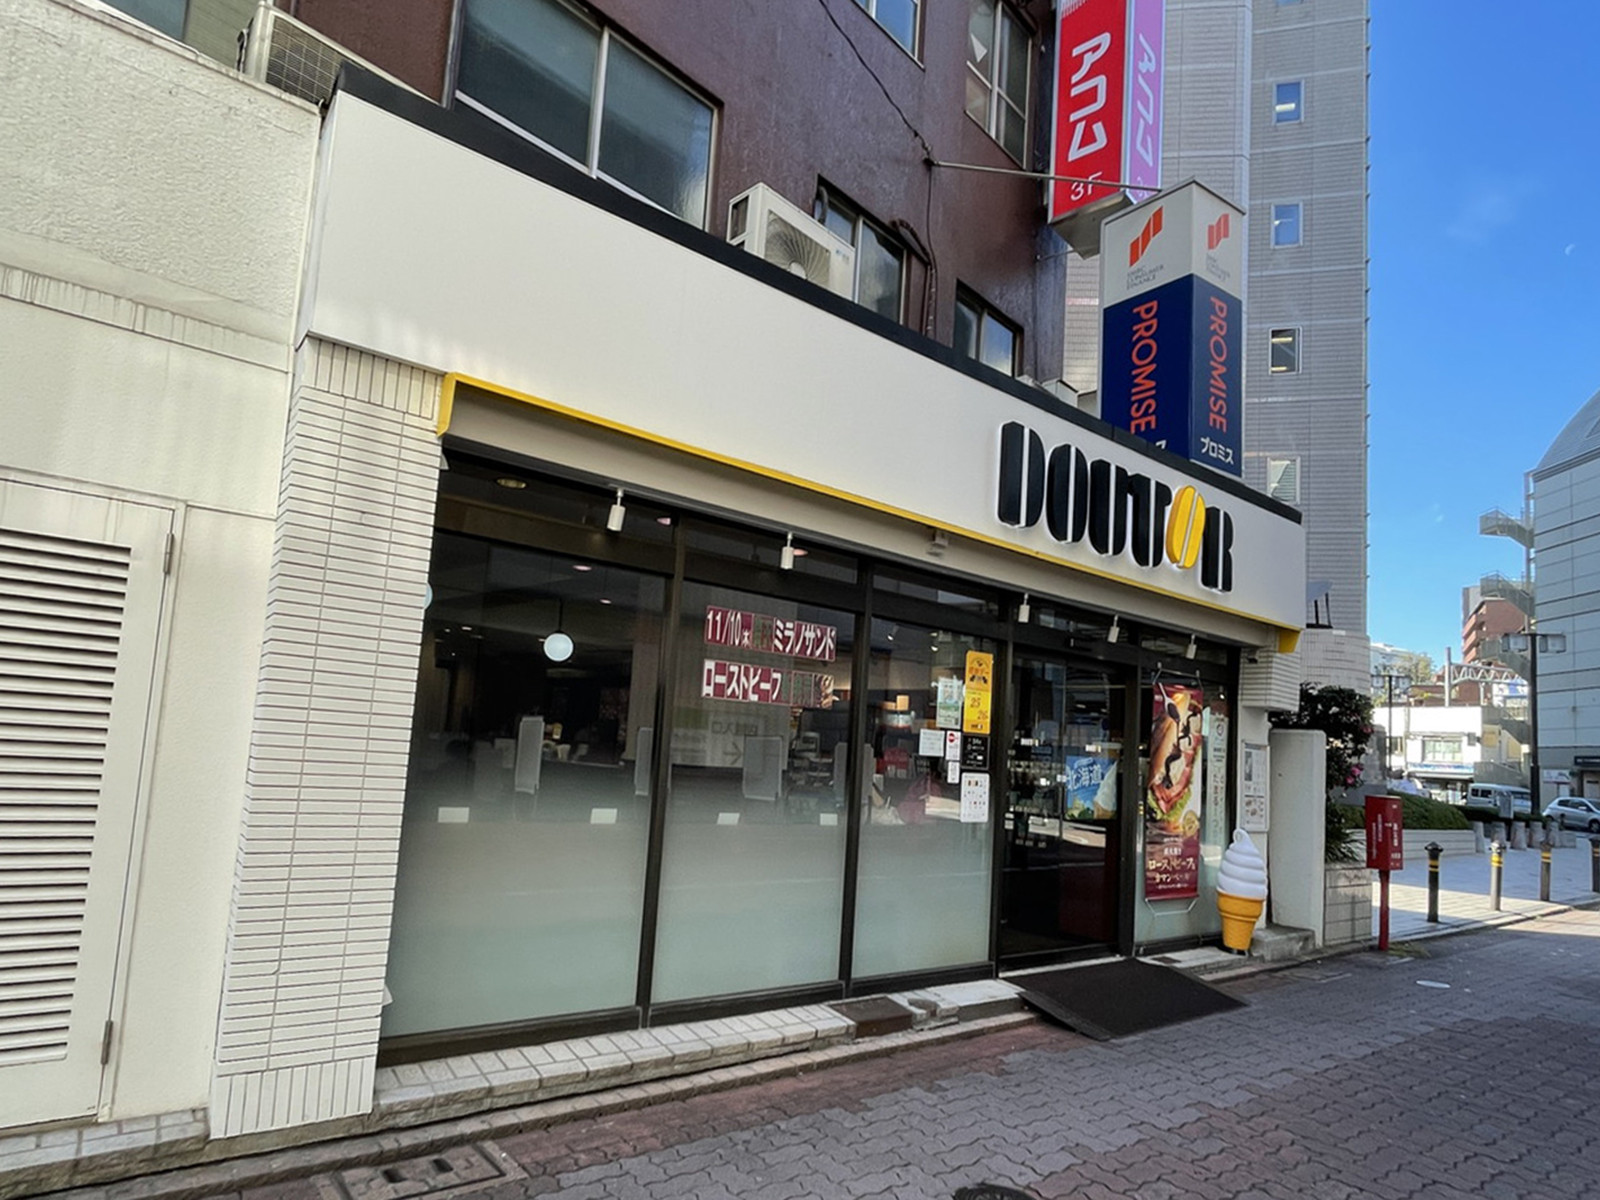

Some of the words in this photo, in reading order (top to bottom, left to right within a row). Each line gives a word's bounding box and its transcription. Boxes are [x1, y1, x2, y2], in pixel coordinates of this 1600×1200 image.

[1068, 31, 1111, 163] アコム
[1070, 171, 1103, 201] 3F
[1131, 299, 1158, 435] PROMISE
[1209, 296, 1229, 433] PROMISE
[1200, 436, 1235, 465] プロミス
[997, 421, 1234, 594] DOUTOR
[702, 660, 782, 701] ローストビーフ
[774, 619, 836, 660] ミラノサンド
